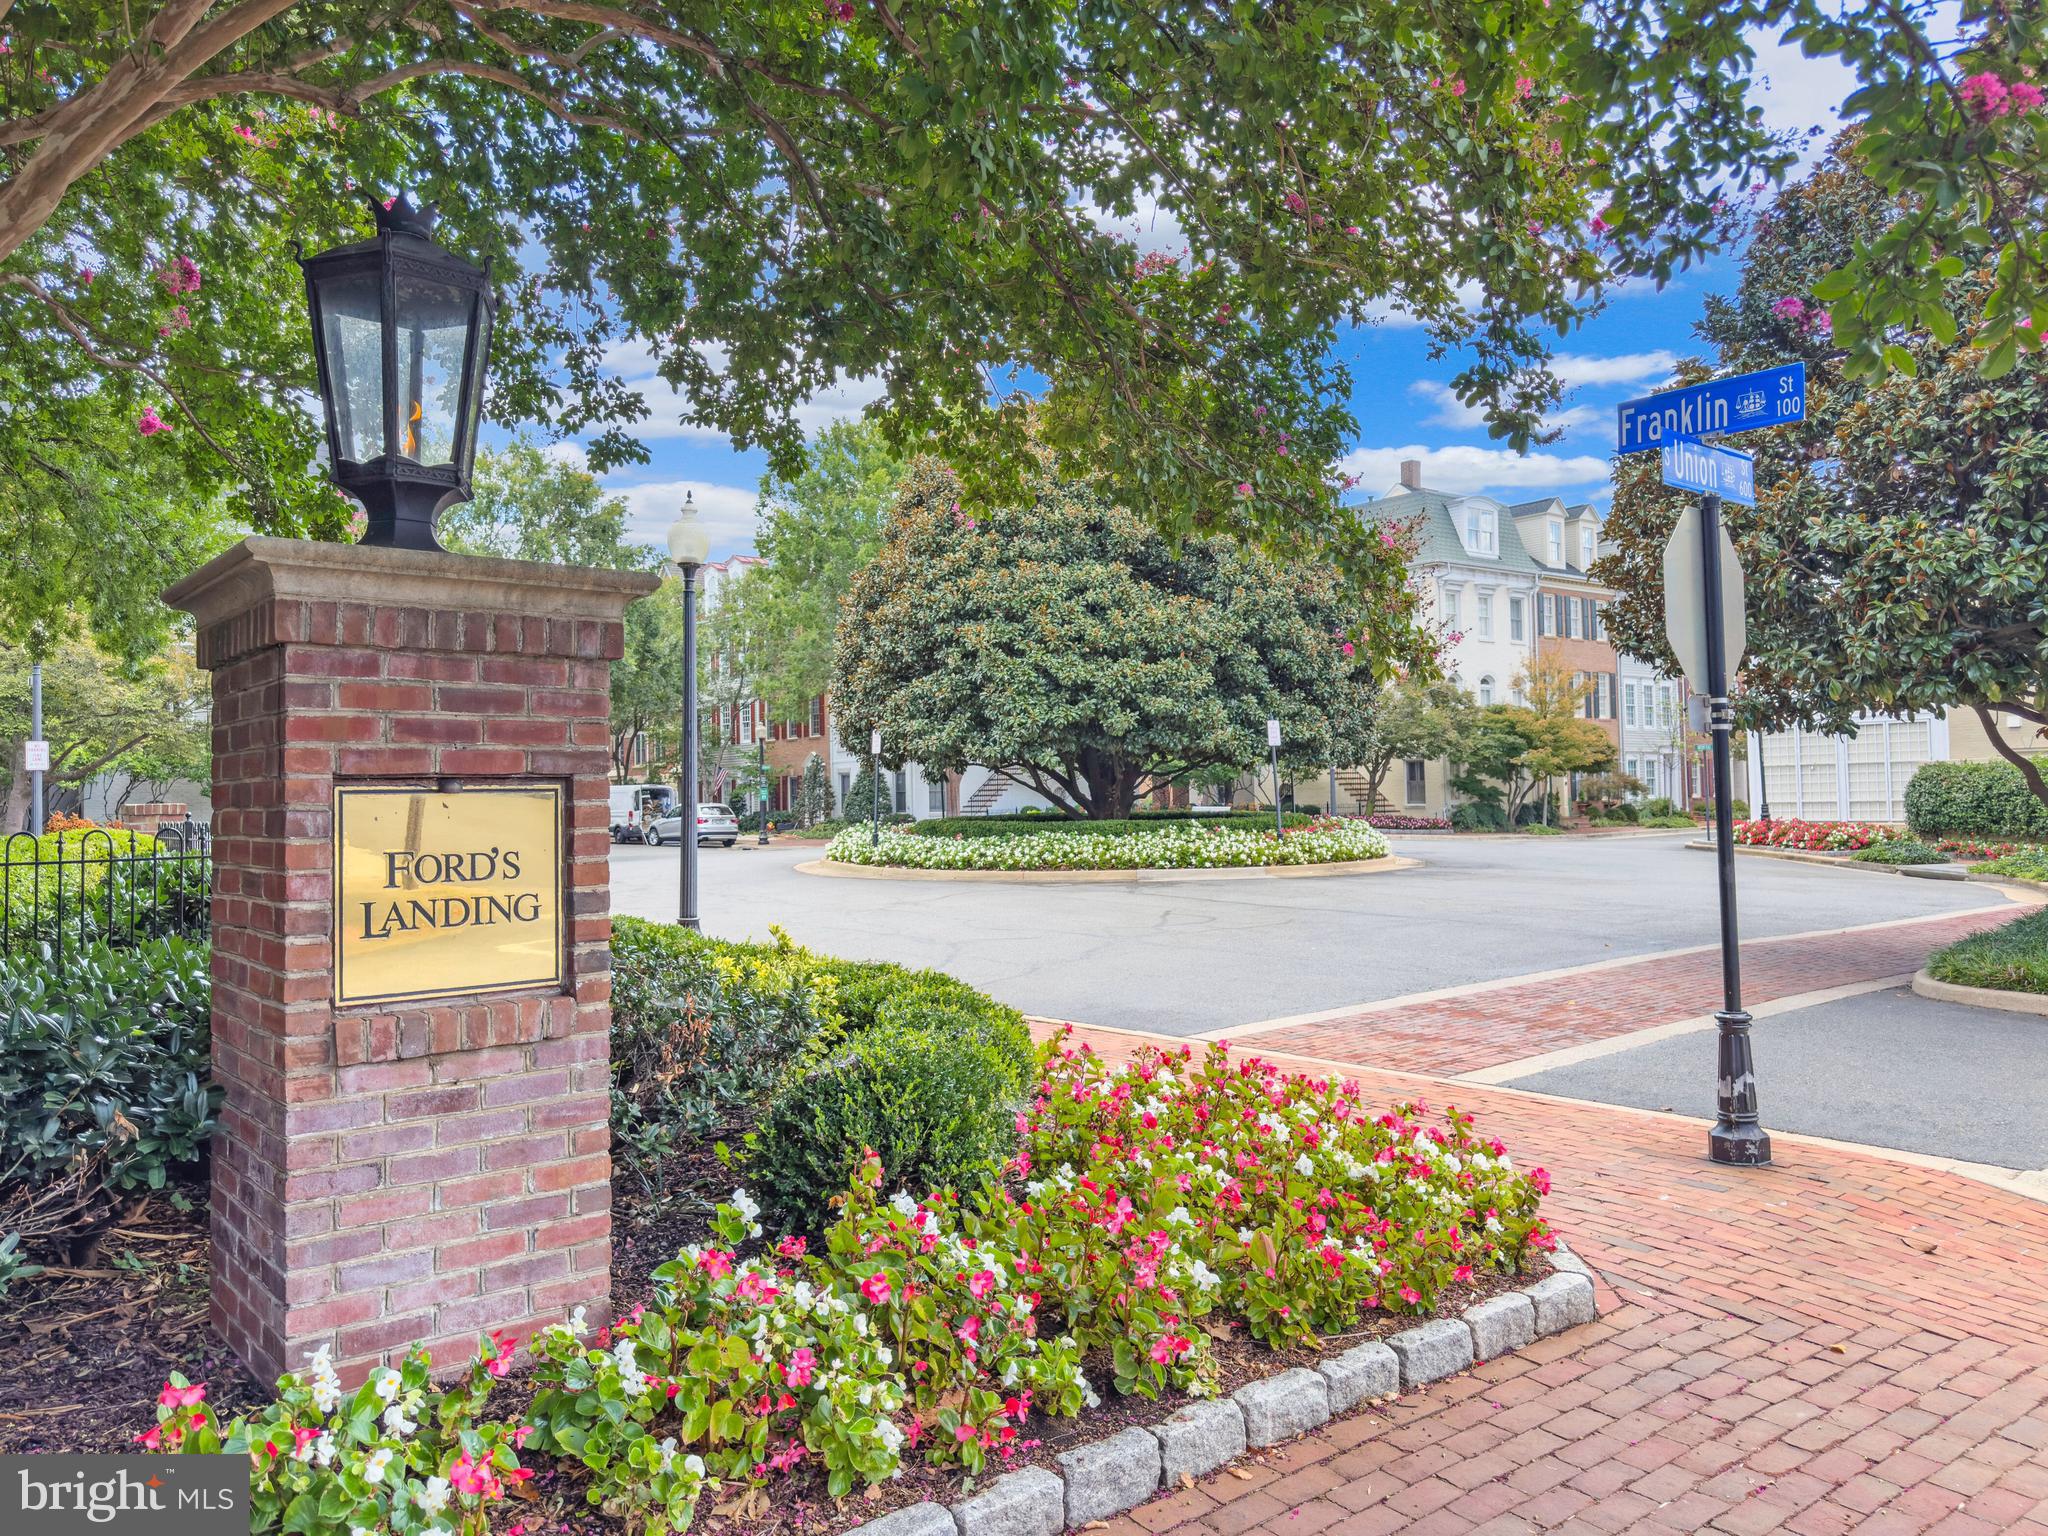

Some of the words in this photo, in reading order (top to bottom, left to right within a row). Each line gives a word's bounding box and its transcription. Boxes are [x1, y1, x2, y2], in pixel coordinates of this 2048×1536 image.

[1776, 397, 1801, 418] 100
[1779, 375, 1794, 395] St
[1621, 392, 1729, 447] Franklin
[1673, 439, 1718, 489] Union
[382, 846, 521, 889] FORD'S
[359, 893, 543, 940] LANDING
